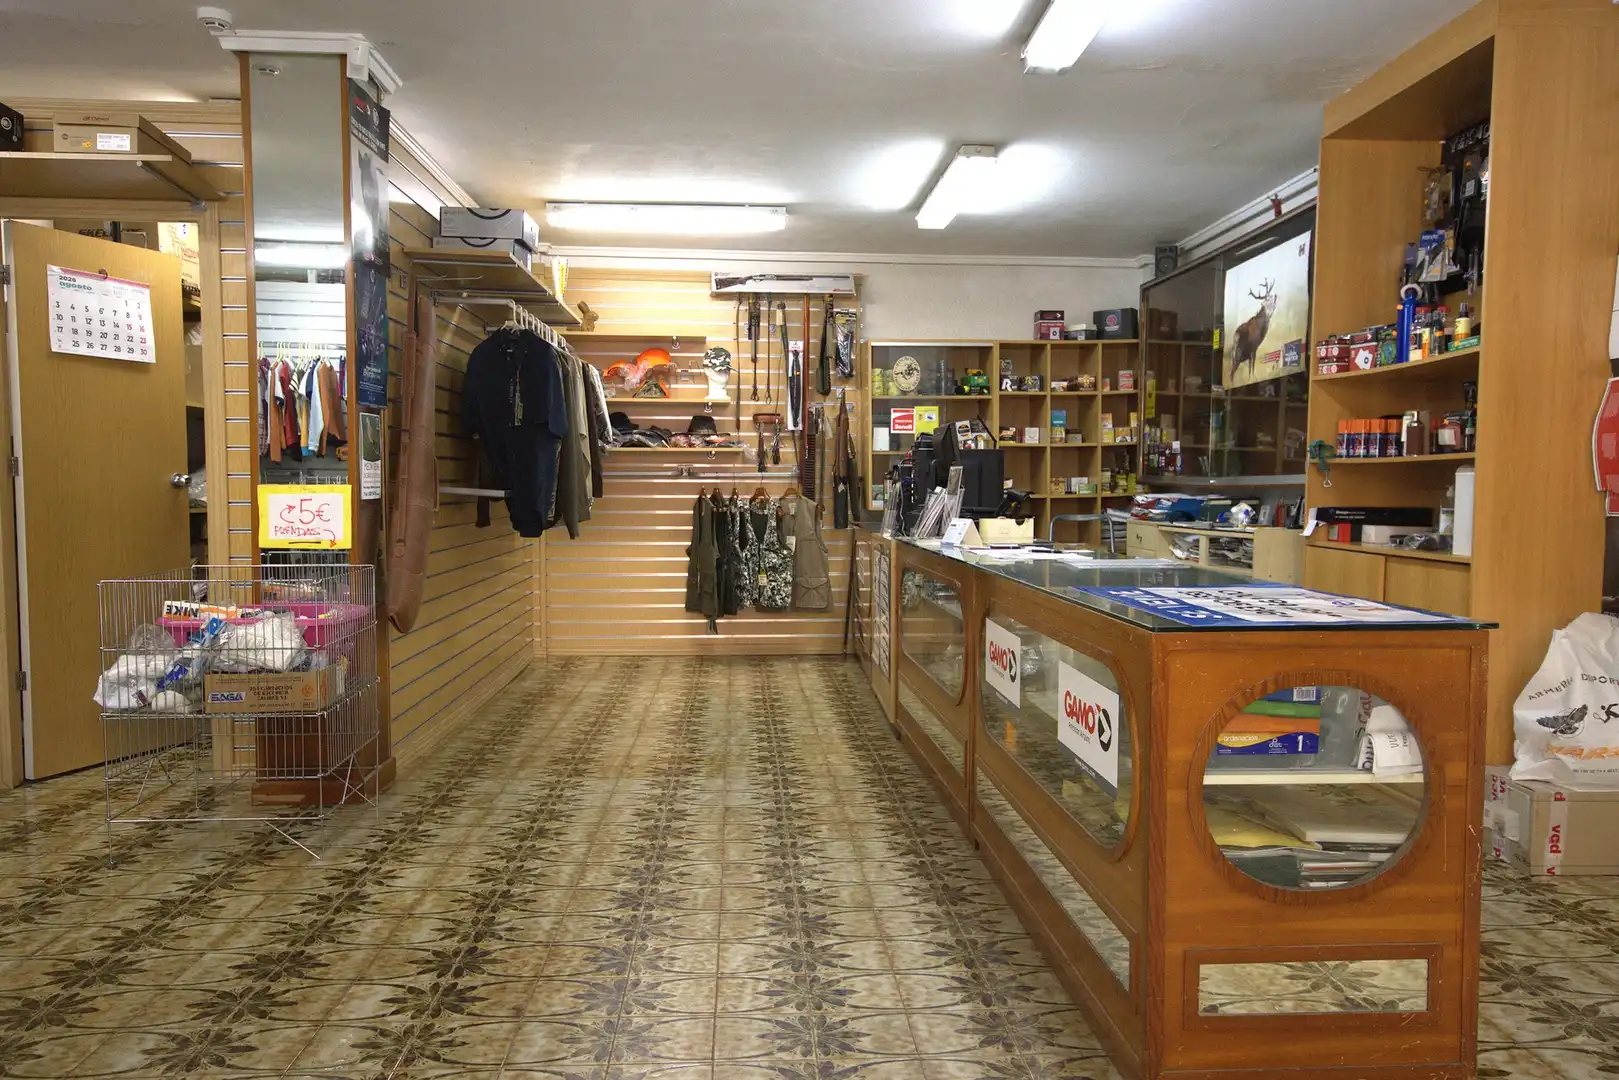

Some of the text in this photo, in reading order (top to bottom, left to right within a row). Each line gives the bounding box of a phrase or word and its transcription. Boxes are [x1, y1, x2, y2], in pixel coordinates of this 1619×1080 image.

[59, 281, 92, 291] agosto
[299, 498, 330, 524] 5€
[274, 526, 320, 536] PRENDAS
[166, 604, 200, 618] NIKE
[989, 640, 1008, 672] GAMO
[211, 693, 244, 701] SAGA
[1064, 690, 1096, 734] GAMO
[1297, 735, 1304, 752] 1
